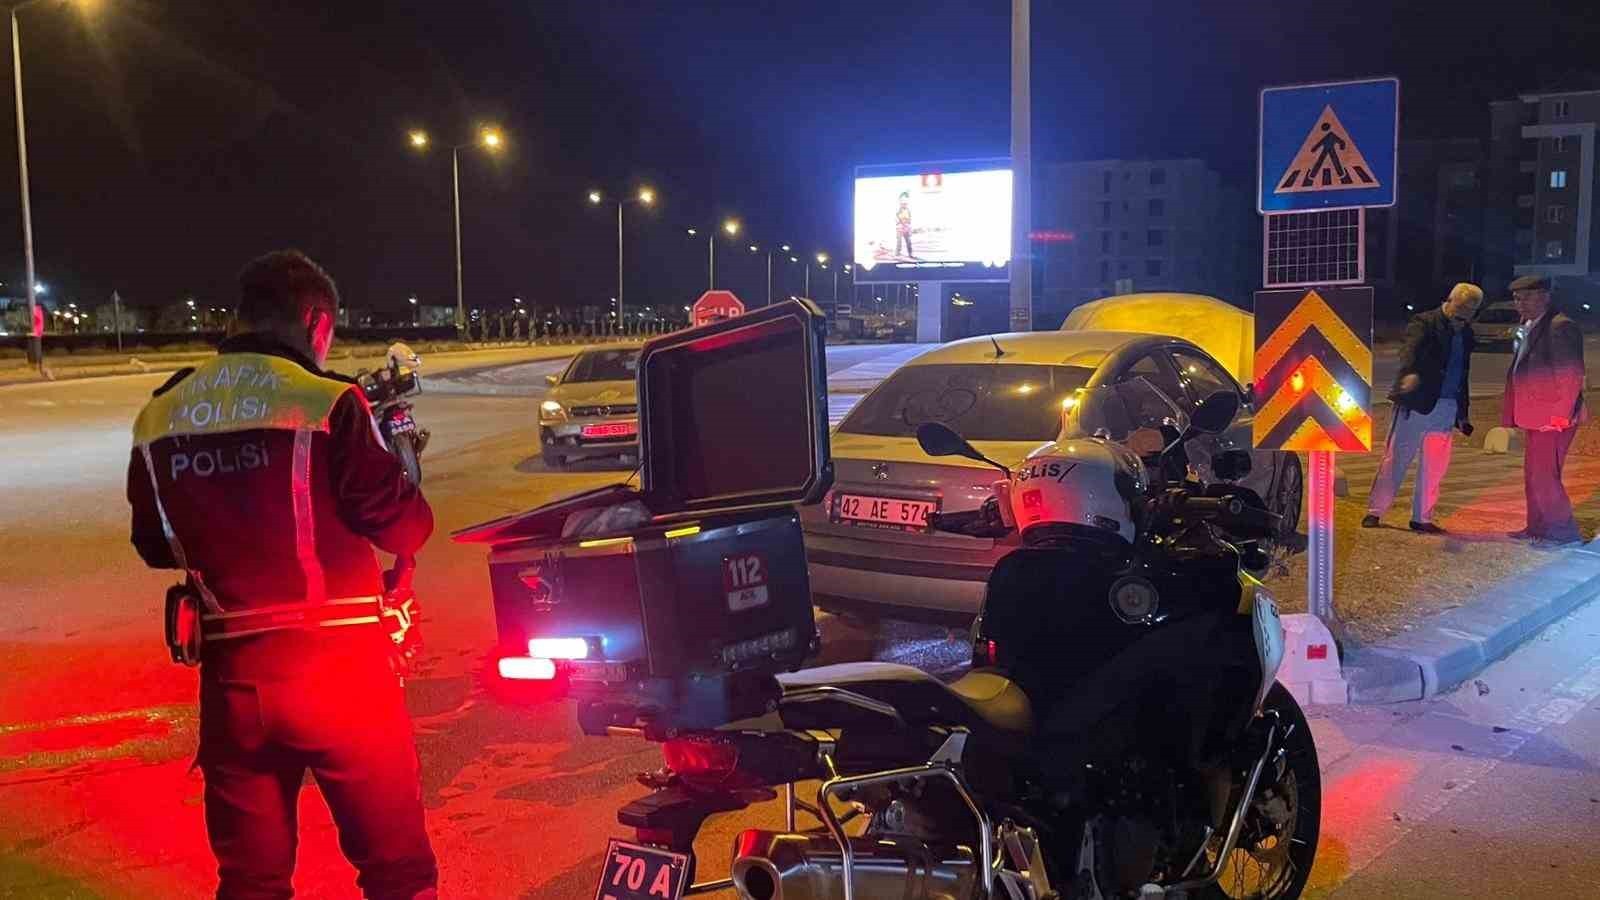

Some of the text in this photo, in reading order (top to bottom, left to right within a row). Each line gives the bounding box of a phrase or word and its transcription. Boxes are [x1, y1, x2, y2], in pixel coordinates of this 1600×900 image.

[842, 498, 930, 523] 42 AE 574
[728, 556, 763, 587] 112
[612, 854, 671, 899] 70 A
